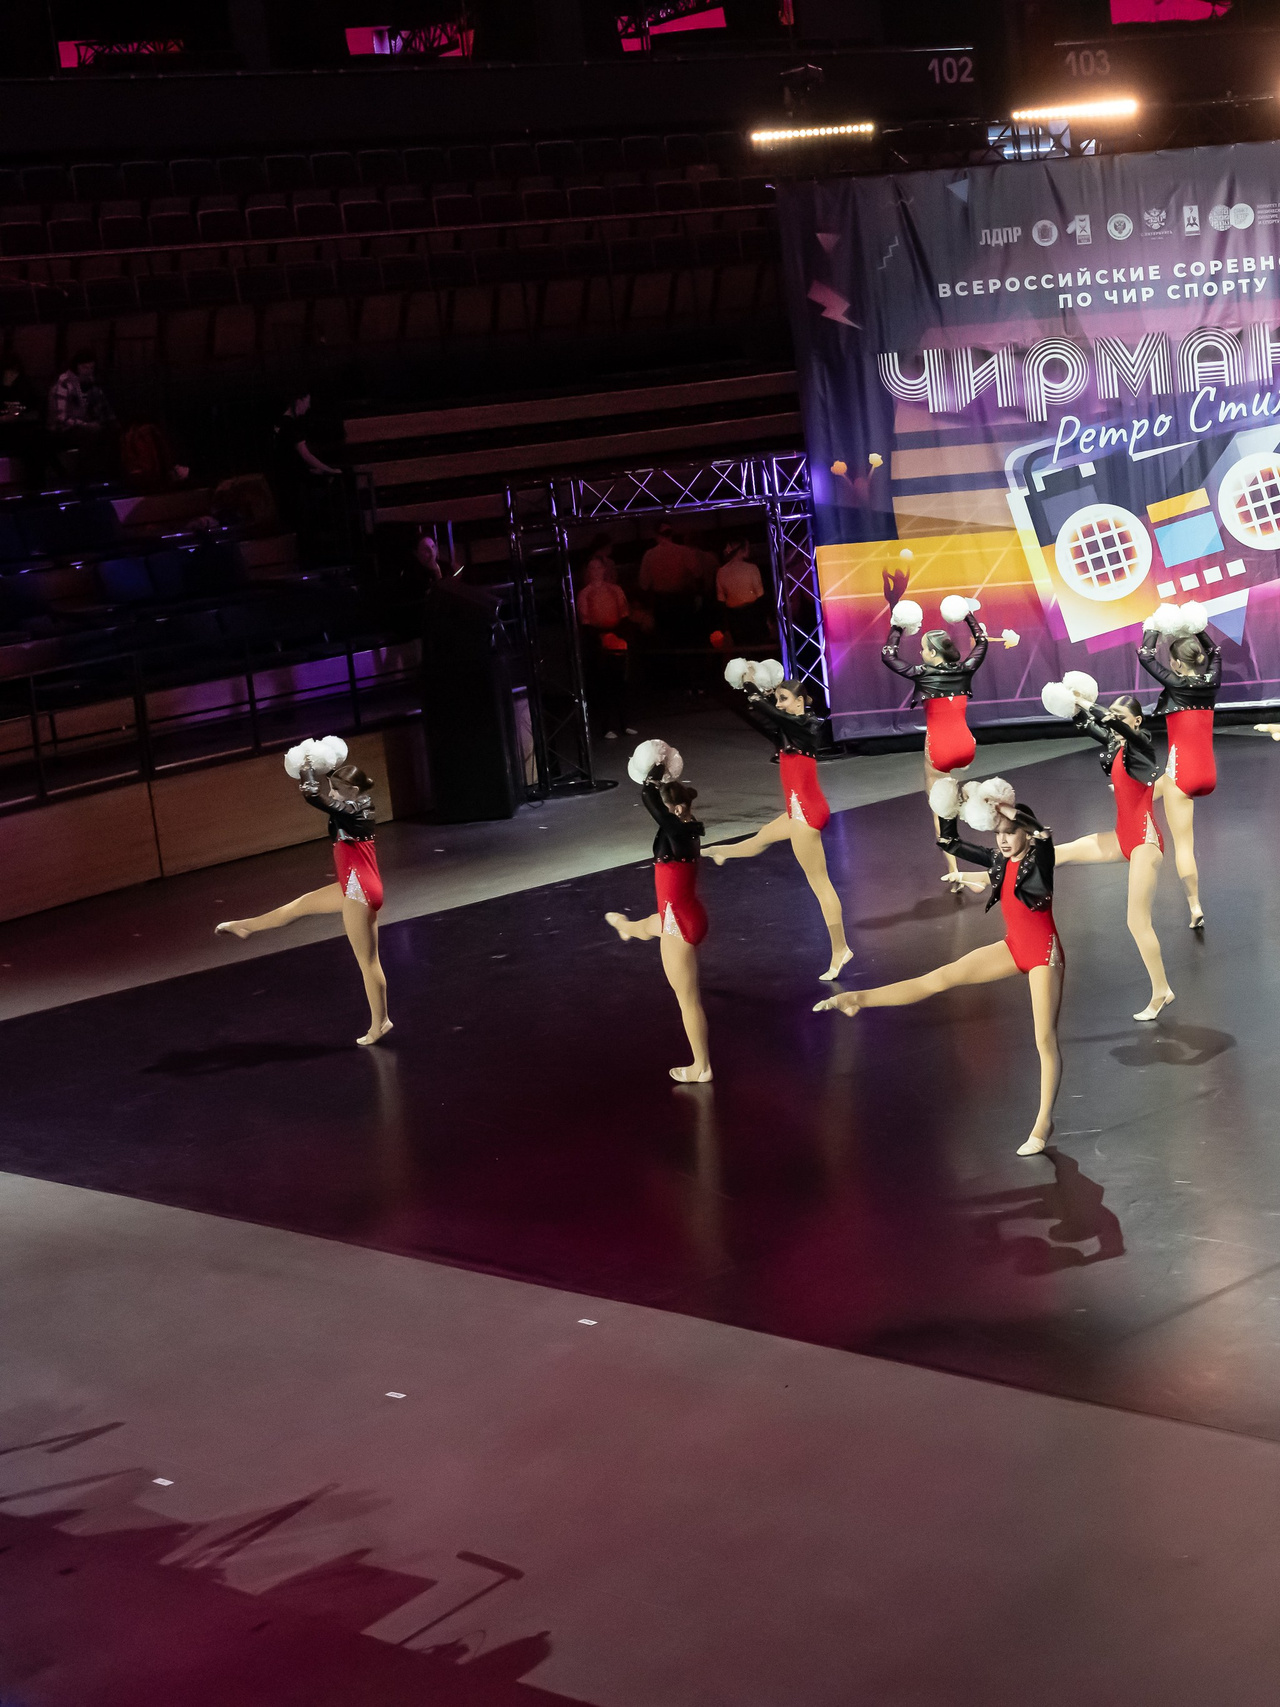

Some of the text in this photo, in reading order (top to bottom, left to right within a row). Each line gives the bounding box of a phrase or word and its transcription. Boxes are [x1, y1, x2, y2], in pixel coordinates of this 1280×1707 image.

[928, 56, 974, 84] 102
[1065, 50, 1111, 76] 103
[979, 226, 1022, 247] ЛДПР
[938, 264, 1161, 298] ВСЕРОССИЙСКИЕ
[1058, 277, 1269, 309] ПО ЧИР СПОРТУ
[1052, 414, 1173, 464] Ретро
